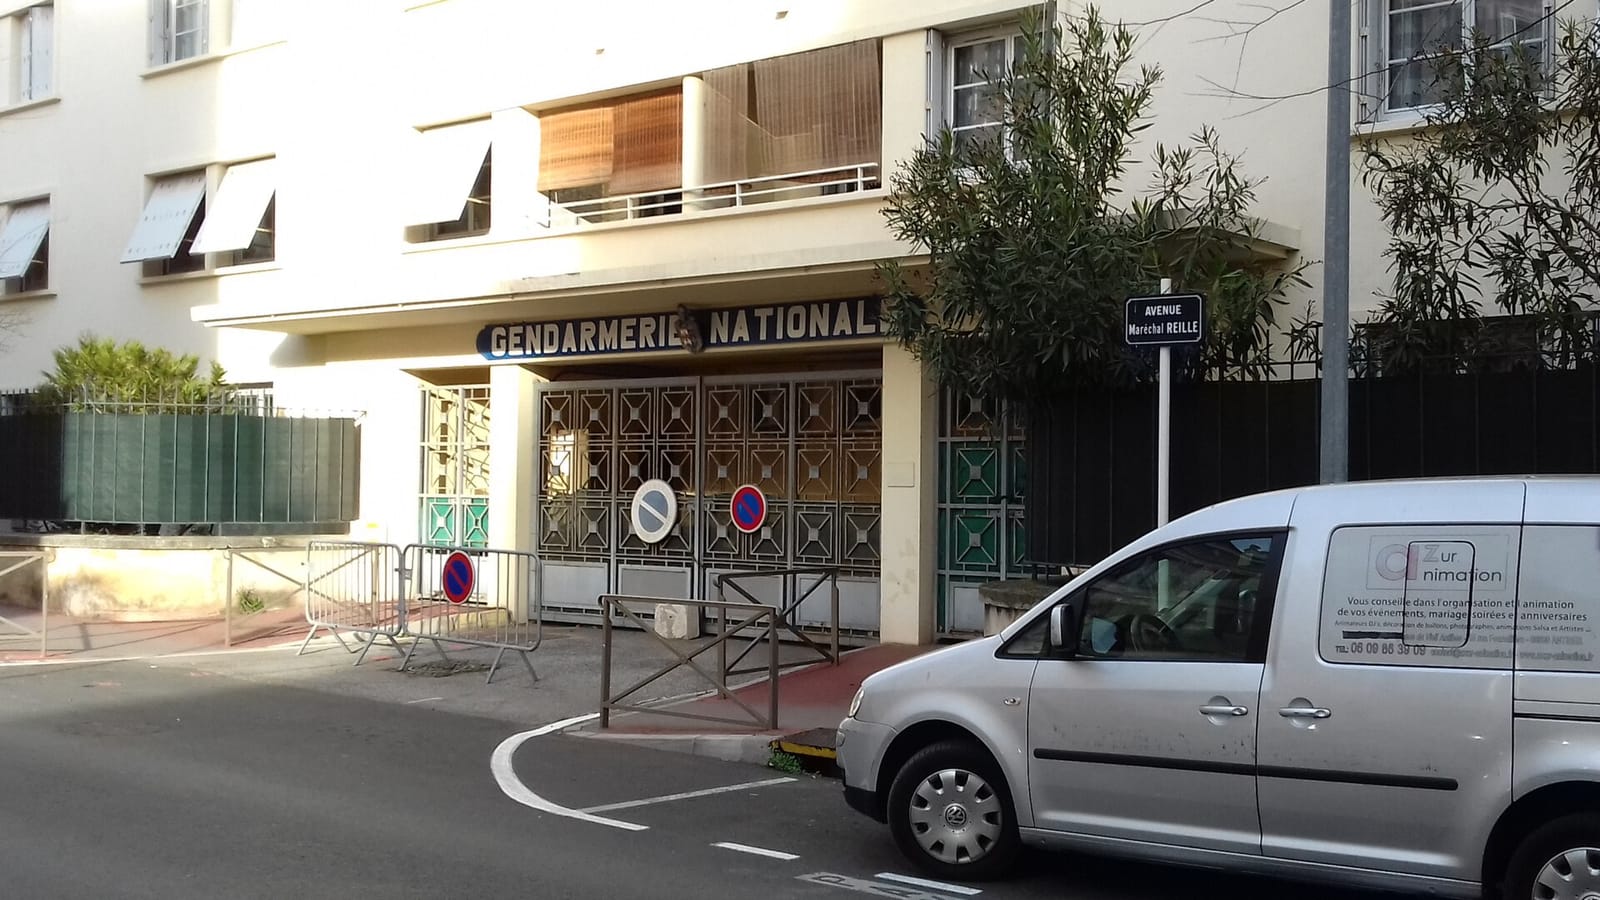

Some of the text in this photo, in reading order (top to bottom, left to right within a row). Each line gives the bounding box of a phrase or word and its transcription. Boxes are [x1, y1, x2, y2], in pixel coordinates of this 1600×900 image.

[1145, 304, 1182, 317] AVENUE
[1128, 321, 1198, 336] Maréchal REILLE
[1347, 597, 1369, 606] Vous
[1413, 598, 1435, 607] dans
[1337, 608, 1349, 617] de
[1350, 609, 1366, 617] vos
[1472, 610, 1506, 620] soirées
